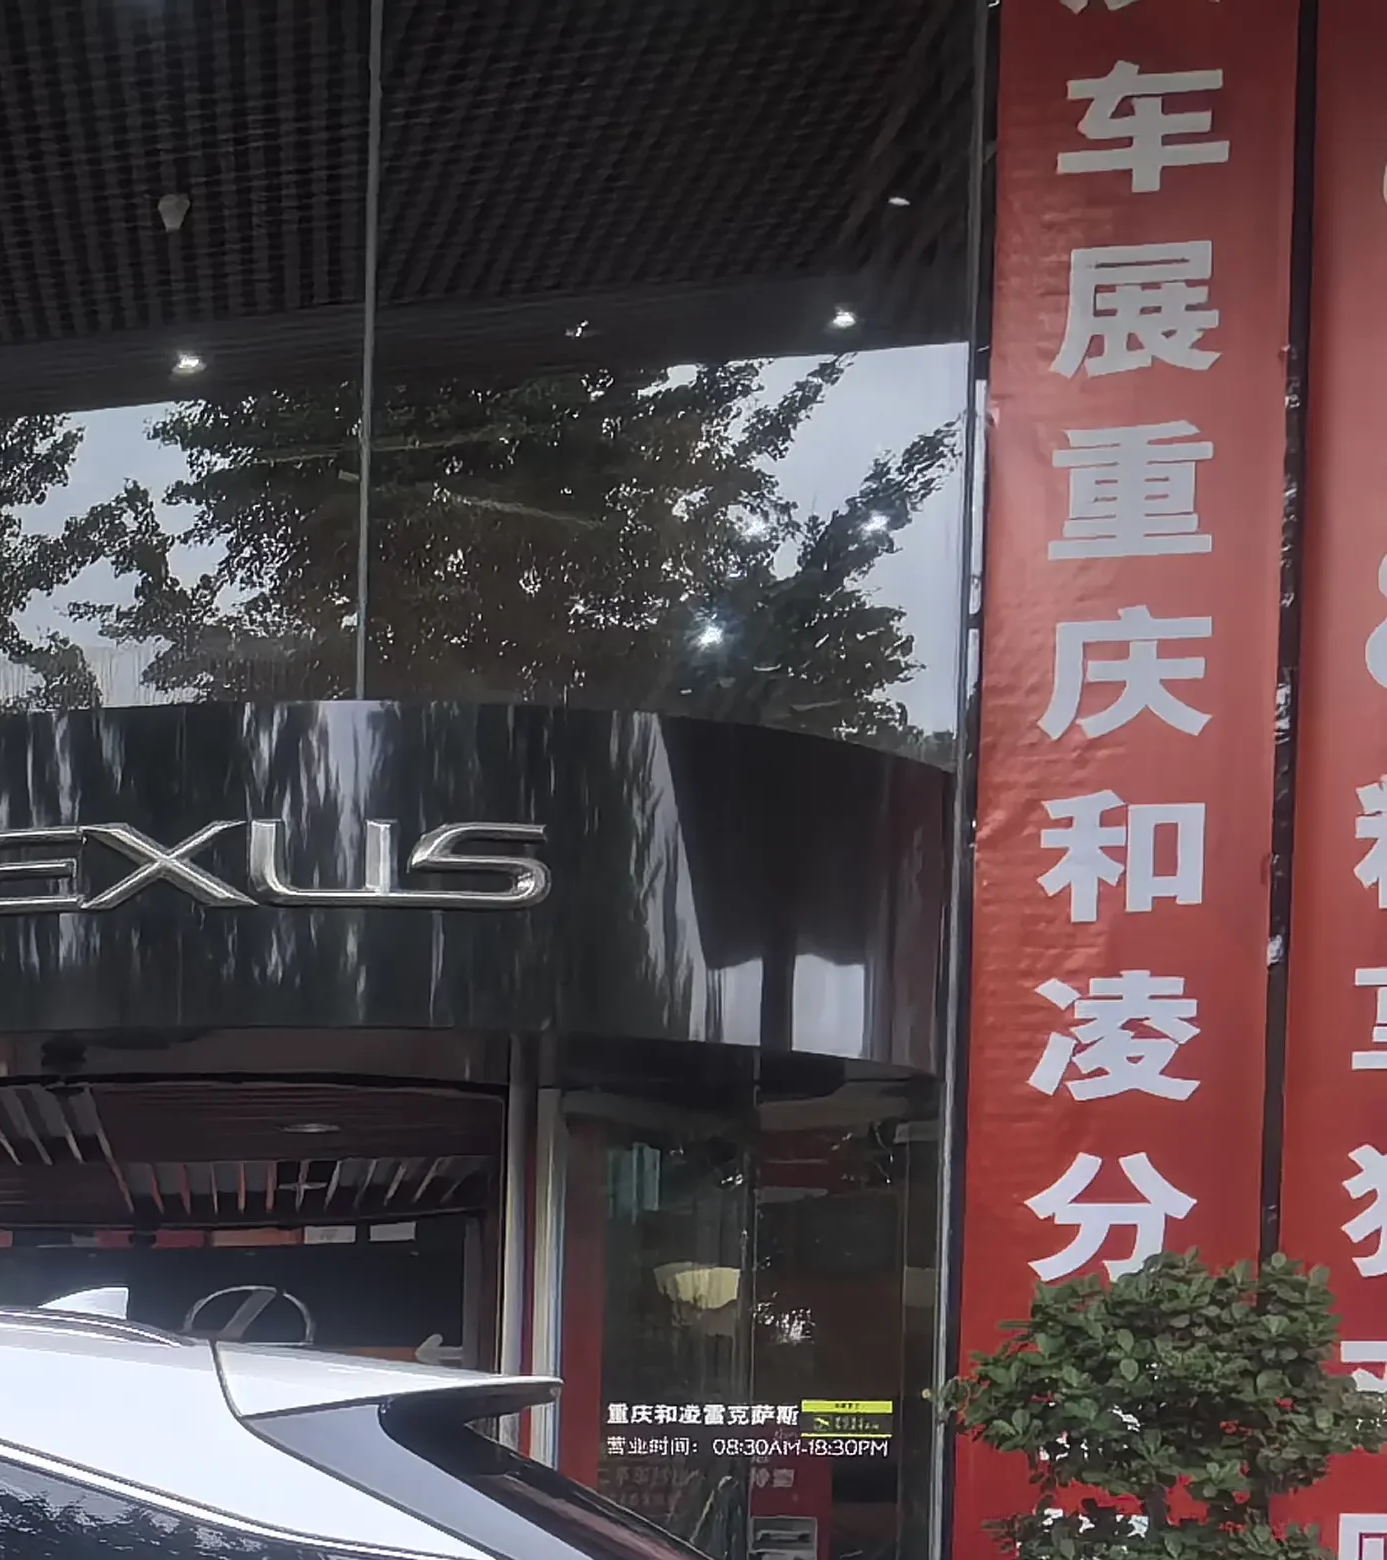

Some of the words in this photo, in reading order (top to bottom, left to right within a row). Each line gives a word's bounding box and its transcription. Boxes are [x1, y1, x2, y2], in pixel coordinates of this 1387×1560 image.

[606, 1402, 799, 1425] 重庆和凌雷克萨斯
